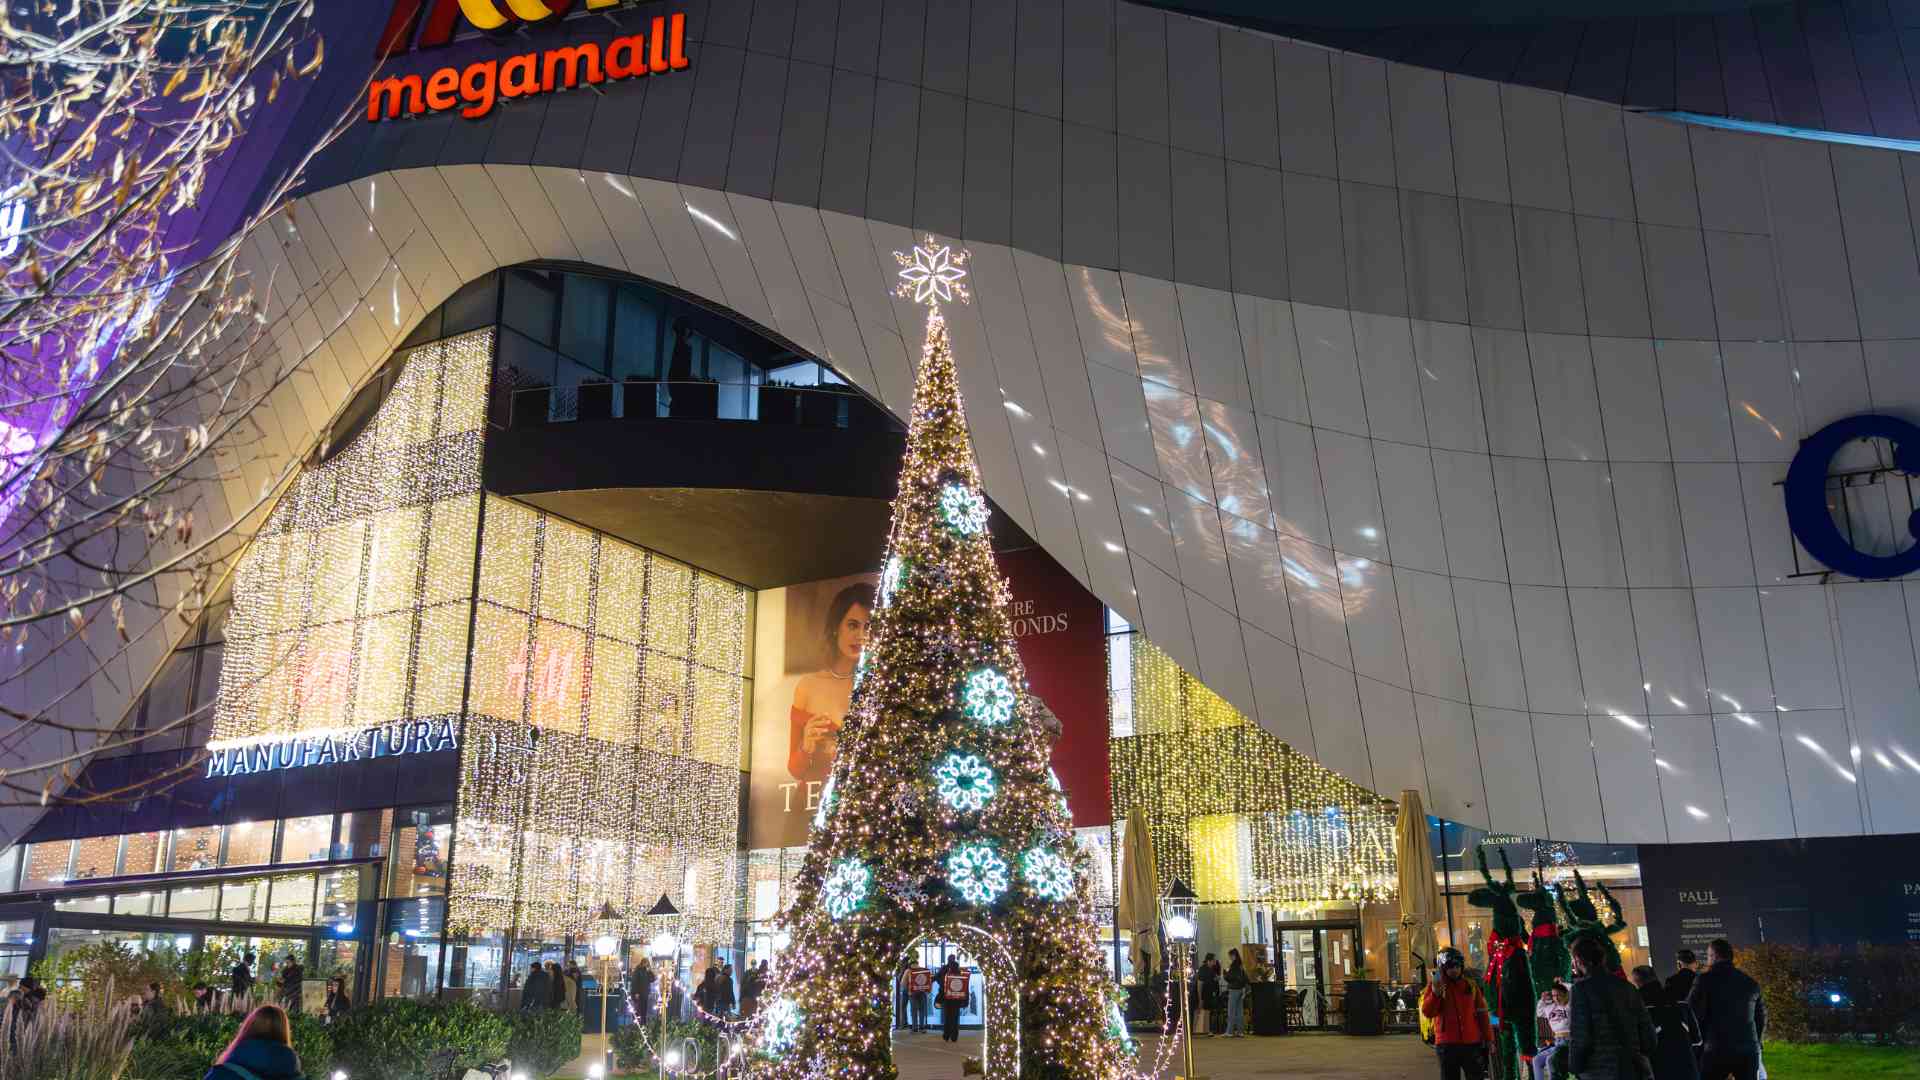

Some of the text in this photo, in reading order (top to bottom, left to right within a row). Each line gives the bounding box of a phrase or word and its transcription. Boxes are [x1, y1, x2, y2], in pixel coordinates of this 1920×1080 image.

[367, 13, 689, 121] megamall
[204, 717, 459, 779] MANUFAKTURA
[1481, 836, 1510, 846] SALON
[1679, 890, 1720, 903] PAUL
